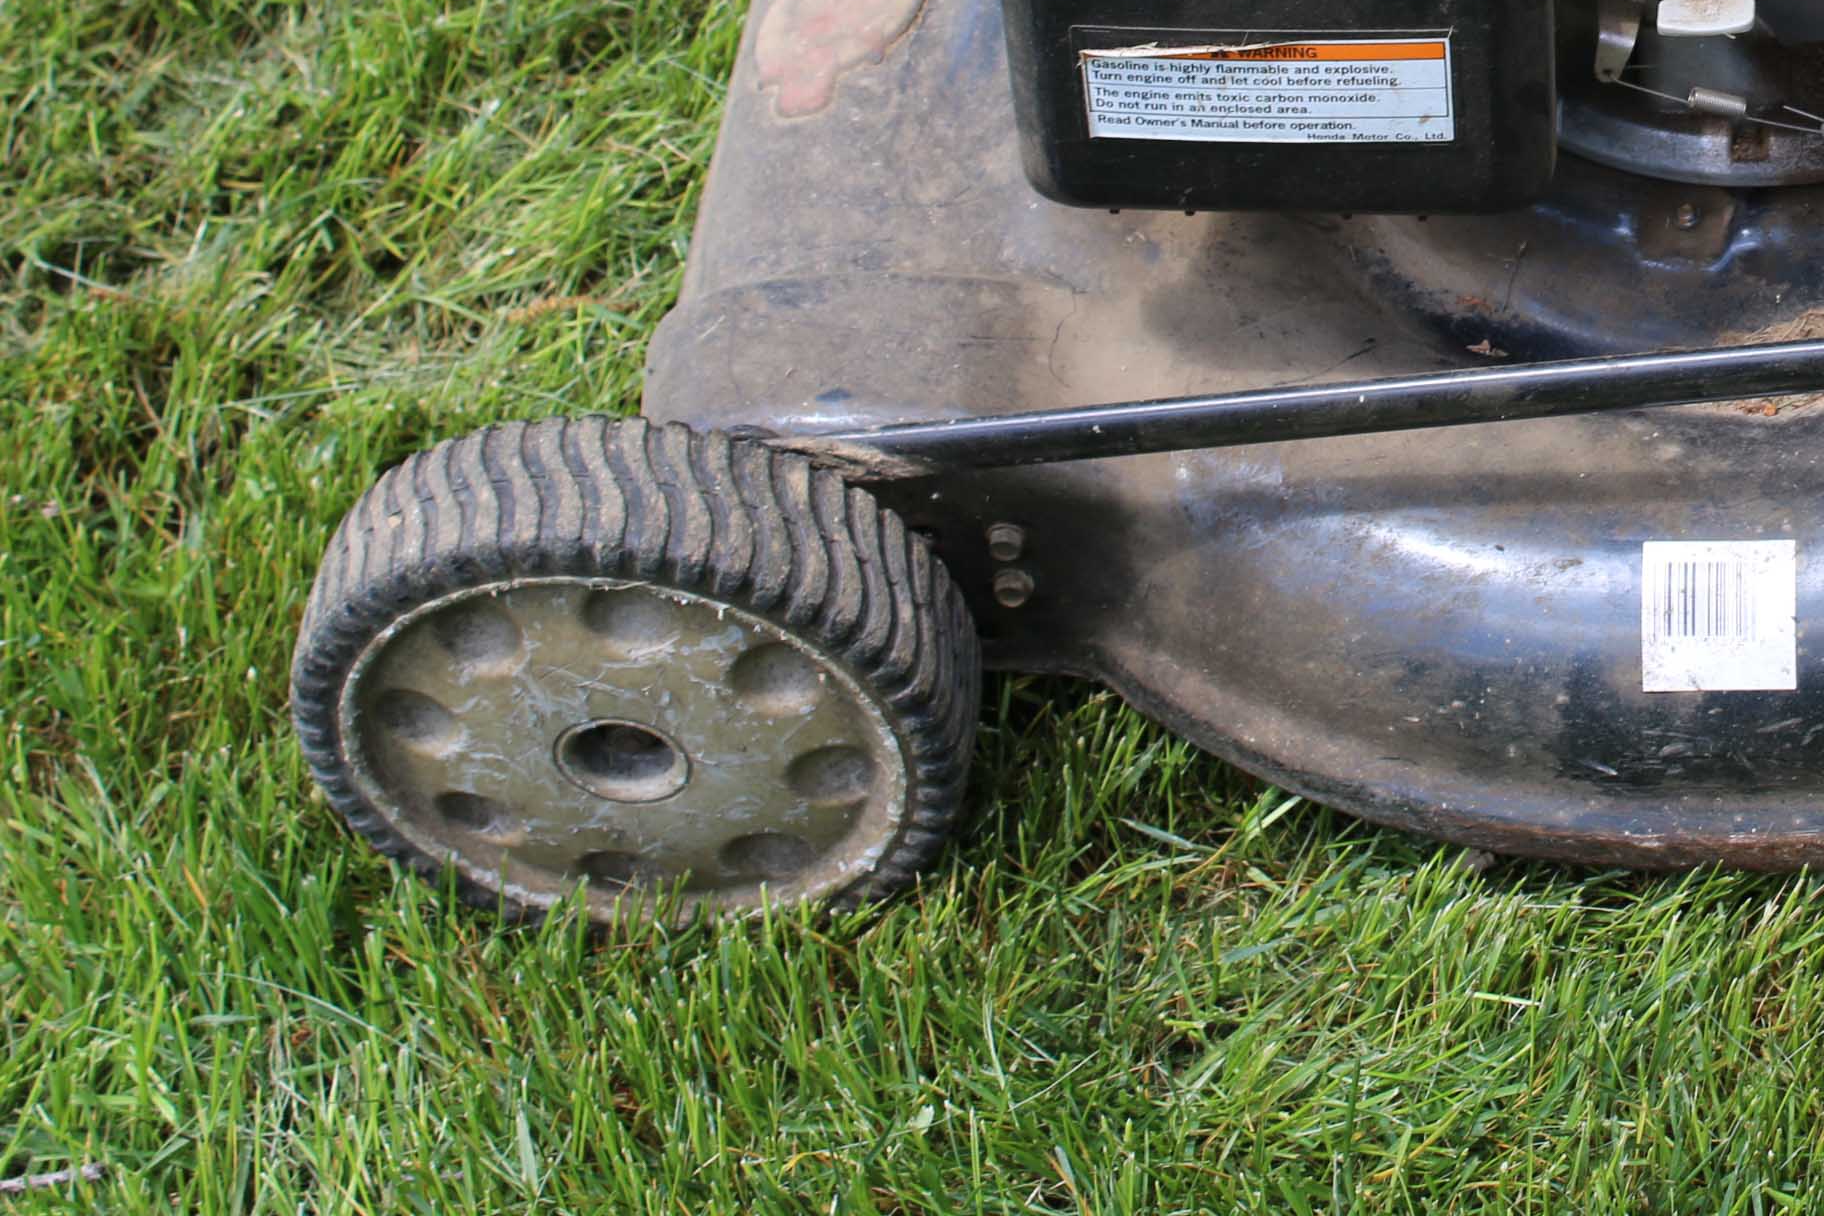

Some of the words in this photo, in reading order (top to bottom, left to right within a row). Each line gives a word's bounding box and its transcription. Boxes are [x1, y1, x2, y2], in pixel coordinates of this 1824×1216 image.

[1238, 47, 1317, 59] WARNING
[1092, 59, 1149, 71] Gasoline
[1154, 63, 1165, 71] is
[1170, 62, 1210, 74] highly
[1216, 64, 1288, 74] flammable
[1294, 65, 1319, 74] and
[1325, 65, 1393, 76] explosive.
[1094, 70, 1122, 81] Turn
[1127, 73, 1172, 84] engine
[1178, 74, 1197, 84] off
[1201, 76, 1226, 85] and
[1231, 77, 1248, 85] let
[1253, 77, 1282, 86] cool
[1287, 76, 1331, 86] before
[1095, 87, 1119, 97] The
[1124, 91, 1169, 101] engine
[1175, 92, 1212, 102] emits
[1217, 93, 1249, 102] toxic
[1255, 94, 1303, 103] carbon
[1308, 93, 1381, 103] monoxide.
[1095, 99, 1113, 108] Do
[1118, 100, 1139, 110] not
[1144, 103, 1167, 111] run
[1172, 103, 1183, 111] in
[1189, 105, 1205, 113] an
[1210, 103, 1272, 114] enclosed
[1277, 106, 1312, 114] area.
[1098, 114, 1130, 125] Read
[1135, 116, 1187, 128] Owner's
[1191, 119, 1239, 129] Manual
[1243, 120, 1288, 130] before
[1290, 121, 1355, 132] operation.
[1307, 133, 1346, 141] Honda
[1352, 133, 1389, 141] Motor
[1425, 132, 1447, 141] Ltd.
